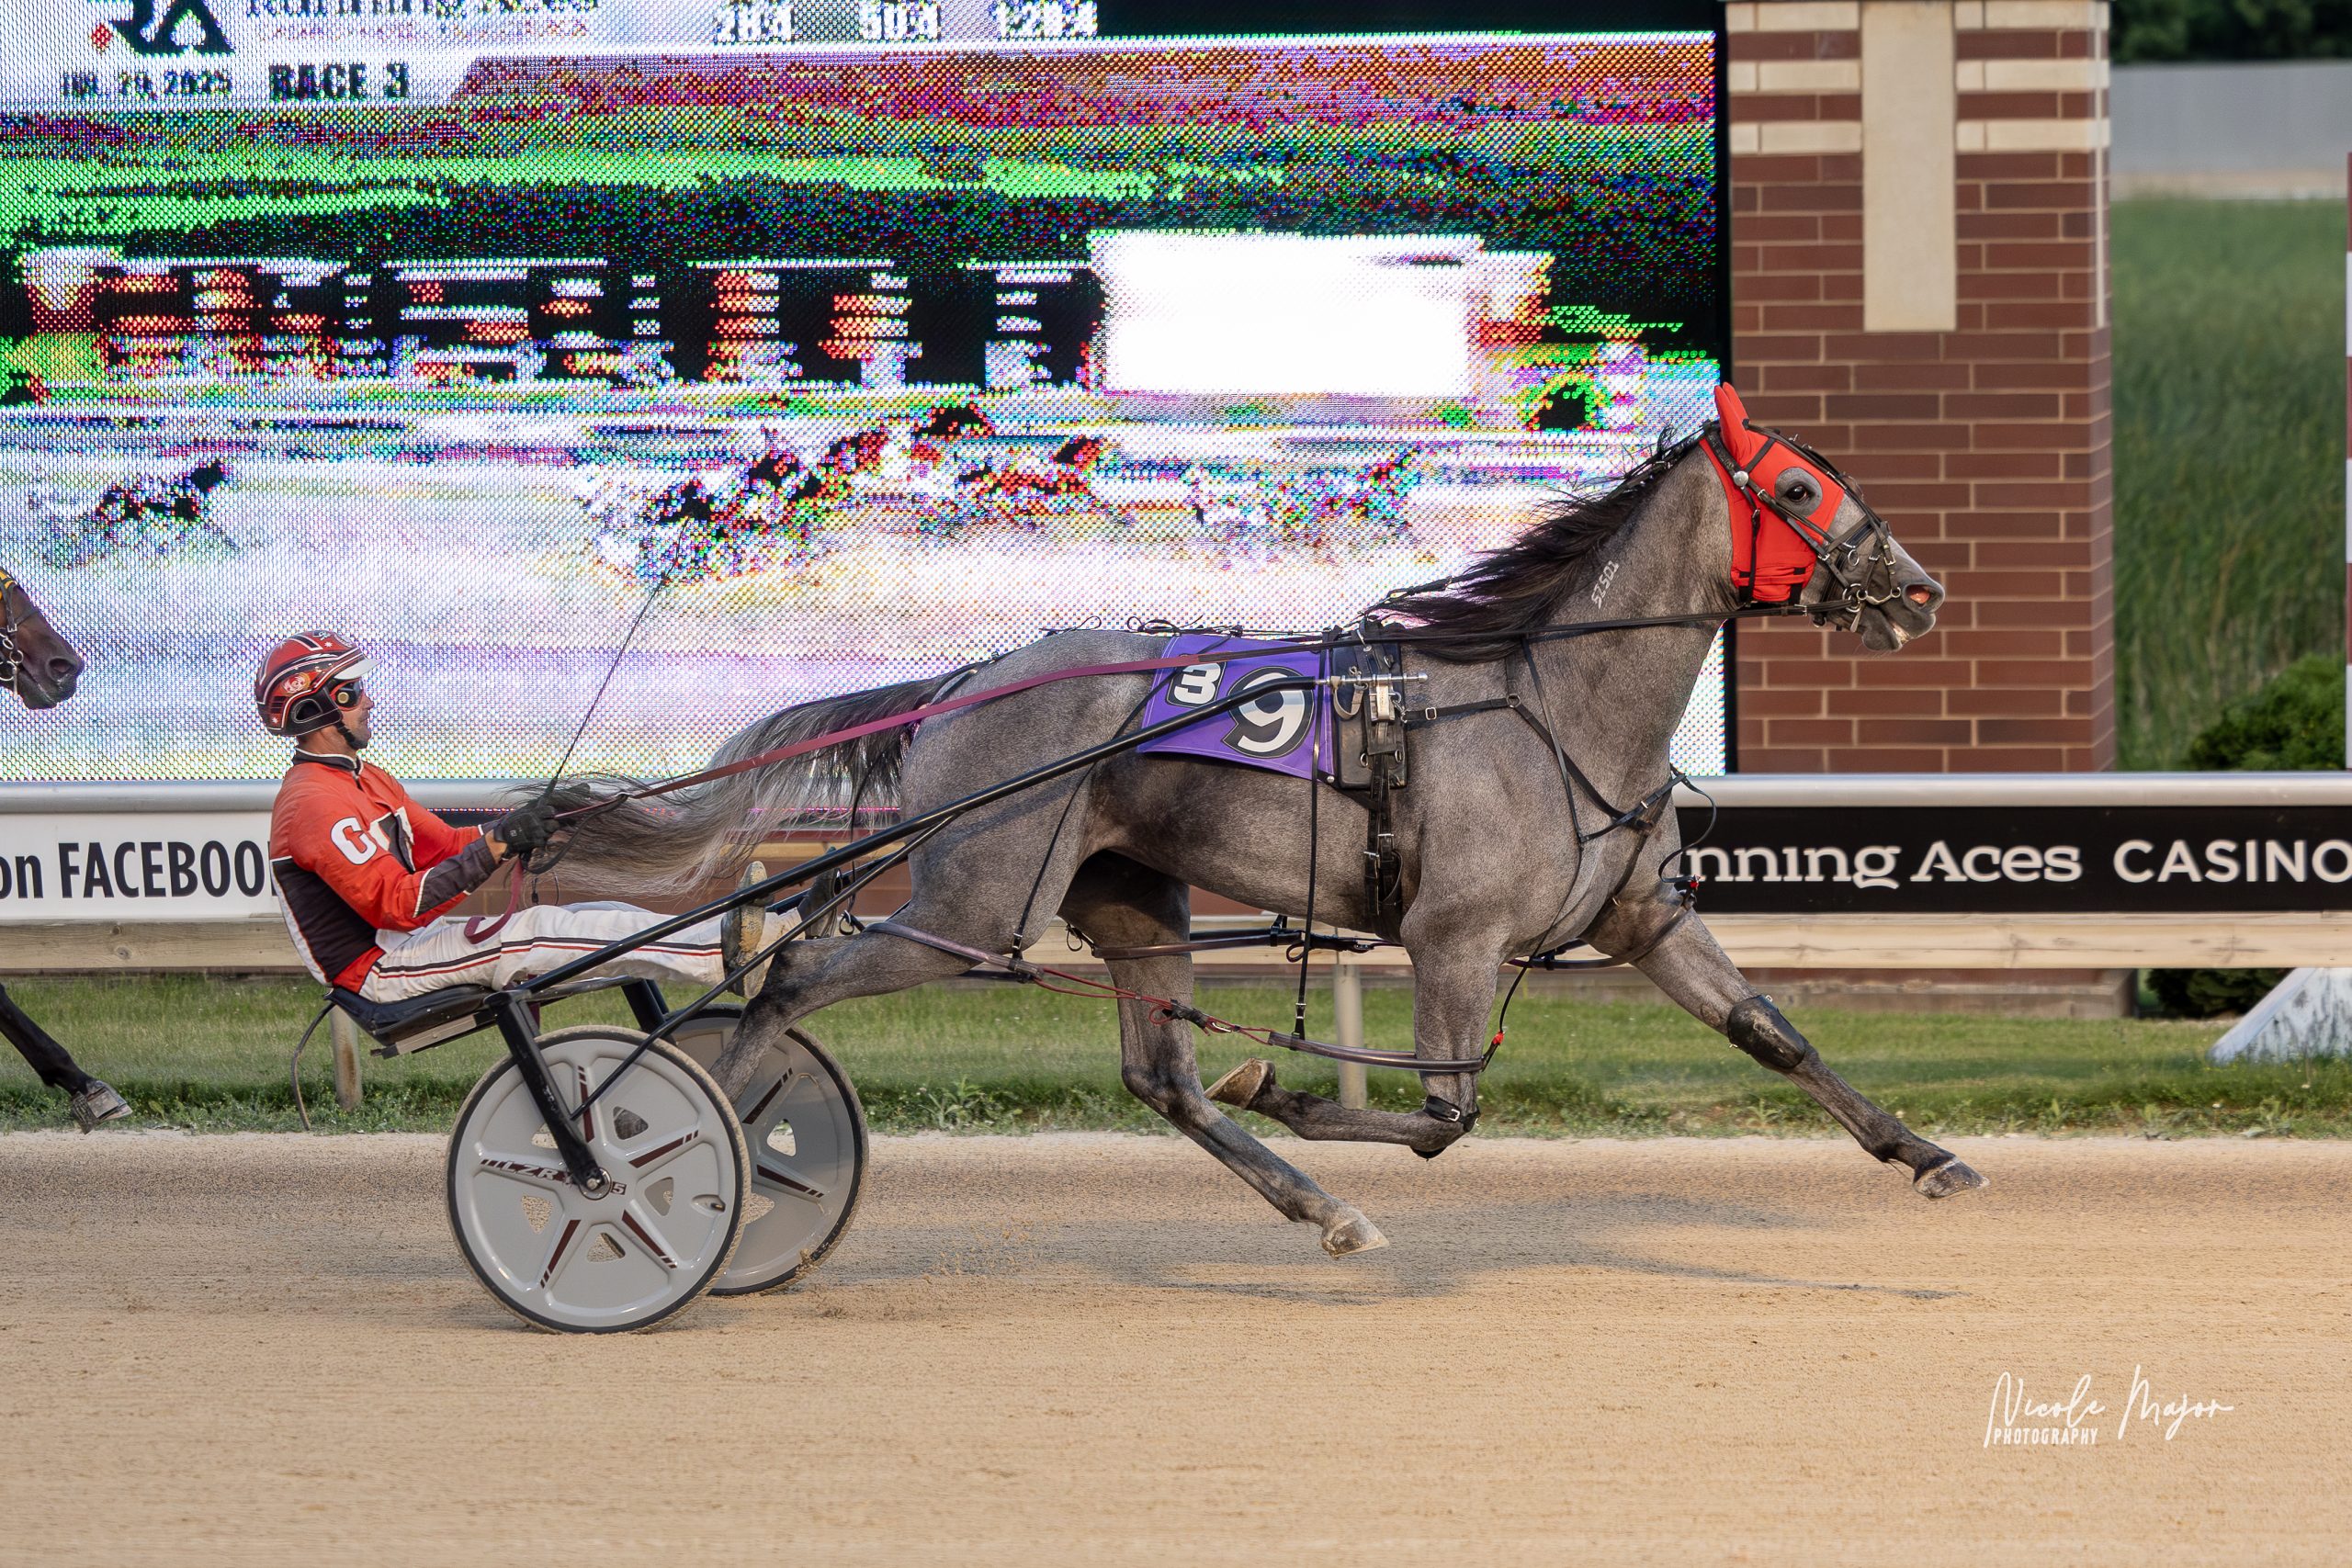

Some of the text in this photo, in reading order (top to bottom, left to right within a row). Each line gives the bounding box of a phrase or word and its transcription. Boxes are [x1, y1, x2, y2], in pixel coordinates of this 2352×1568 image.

[268, 62, 410, 101] RACE 3
[1173, 661, 1223, 706] 3
[1238, 671, 1306, 753] 9
[58, 840, 277, 899] FACEBOO
[1909, 840, 2082, 882] Aces
[2113, 840, 2352, 883] CASINO
